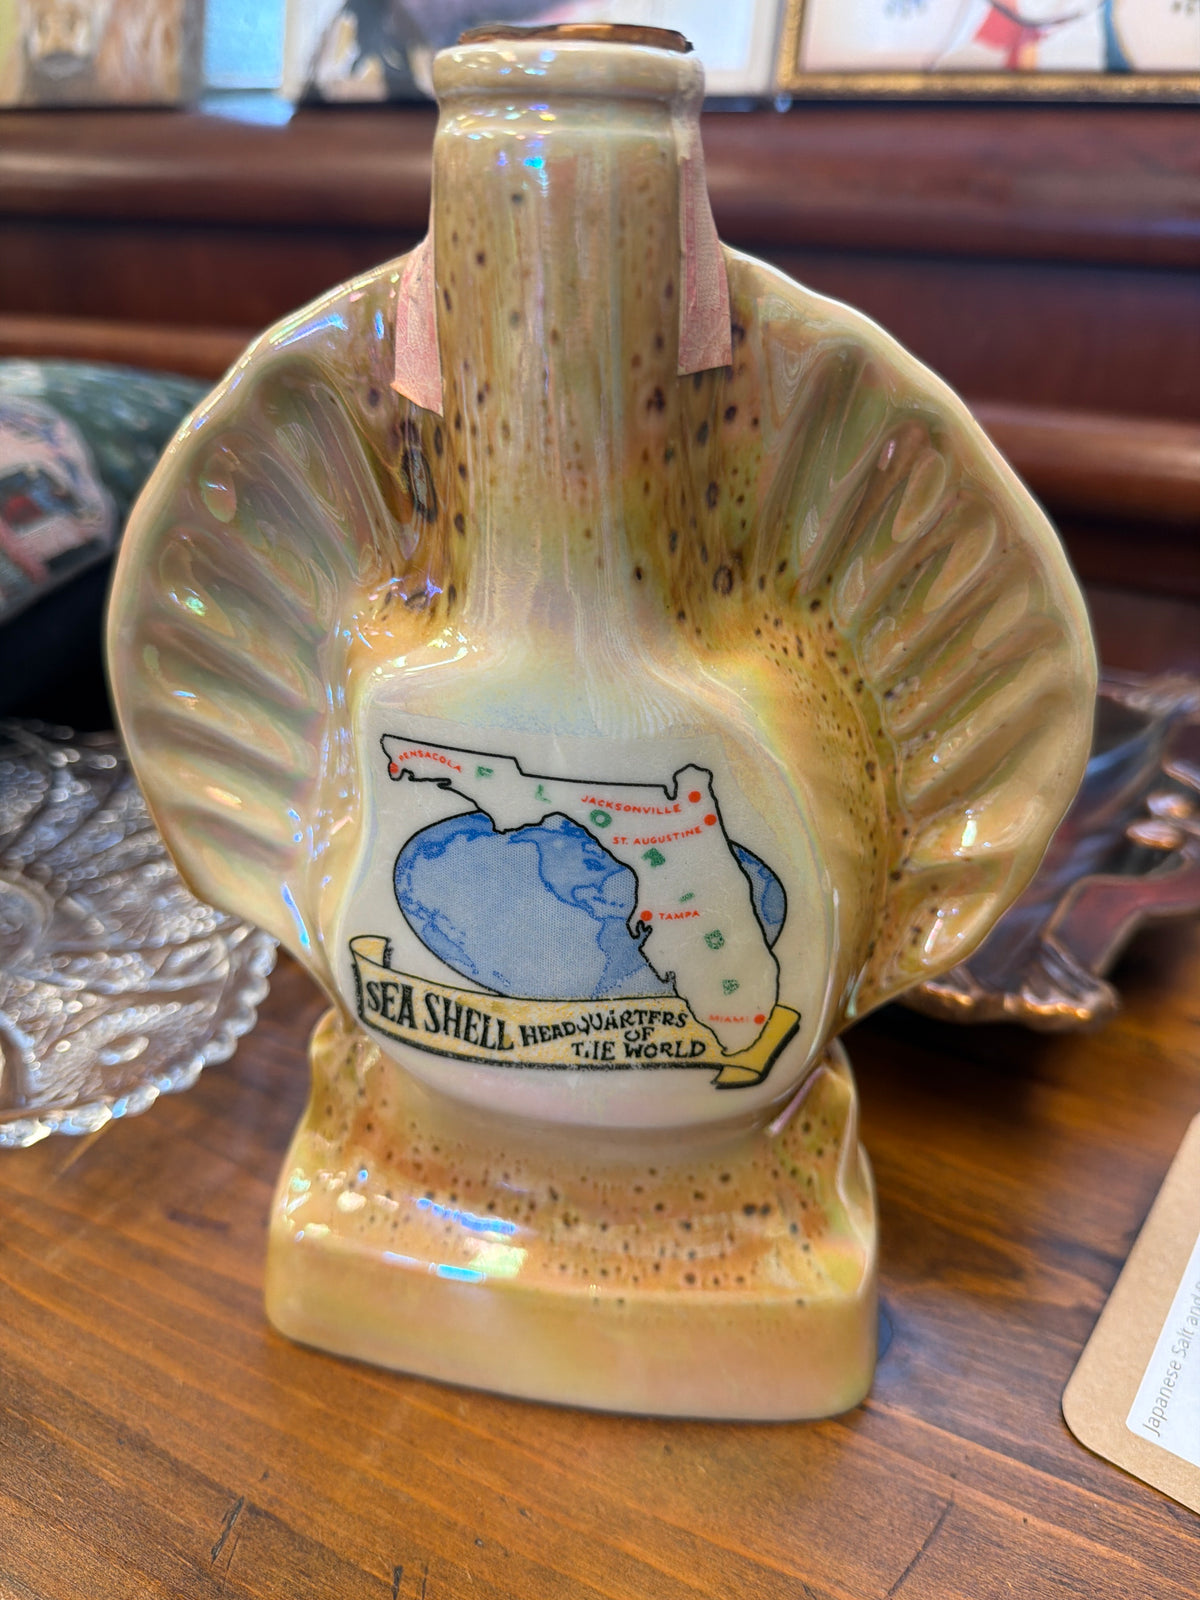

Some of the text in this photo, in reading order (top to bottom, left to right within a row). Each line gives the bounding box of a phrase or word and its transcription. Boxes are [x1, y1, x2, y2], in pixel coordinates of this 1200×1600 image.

[399, 750, 462, 774] PENSACOLA
[581, 795, 682, 815] JACKSONVILLE
[612, 826, 703, 845] ST. AUGUSTINE
[659, 910, 700, 920] TAMPA
[366, 980, 689, 1050] SEA SHELL HEADQUARTERS
[709, 1014, 750, 1023] MIAMI
[624, 1026, 655, 1042] OF
[623, 1039, 706, 1059] WORLD
[1142, 1293, 1200, 1438] Japanese Salt and
